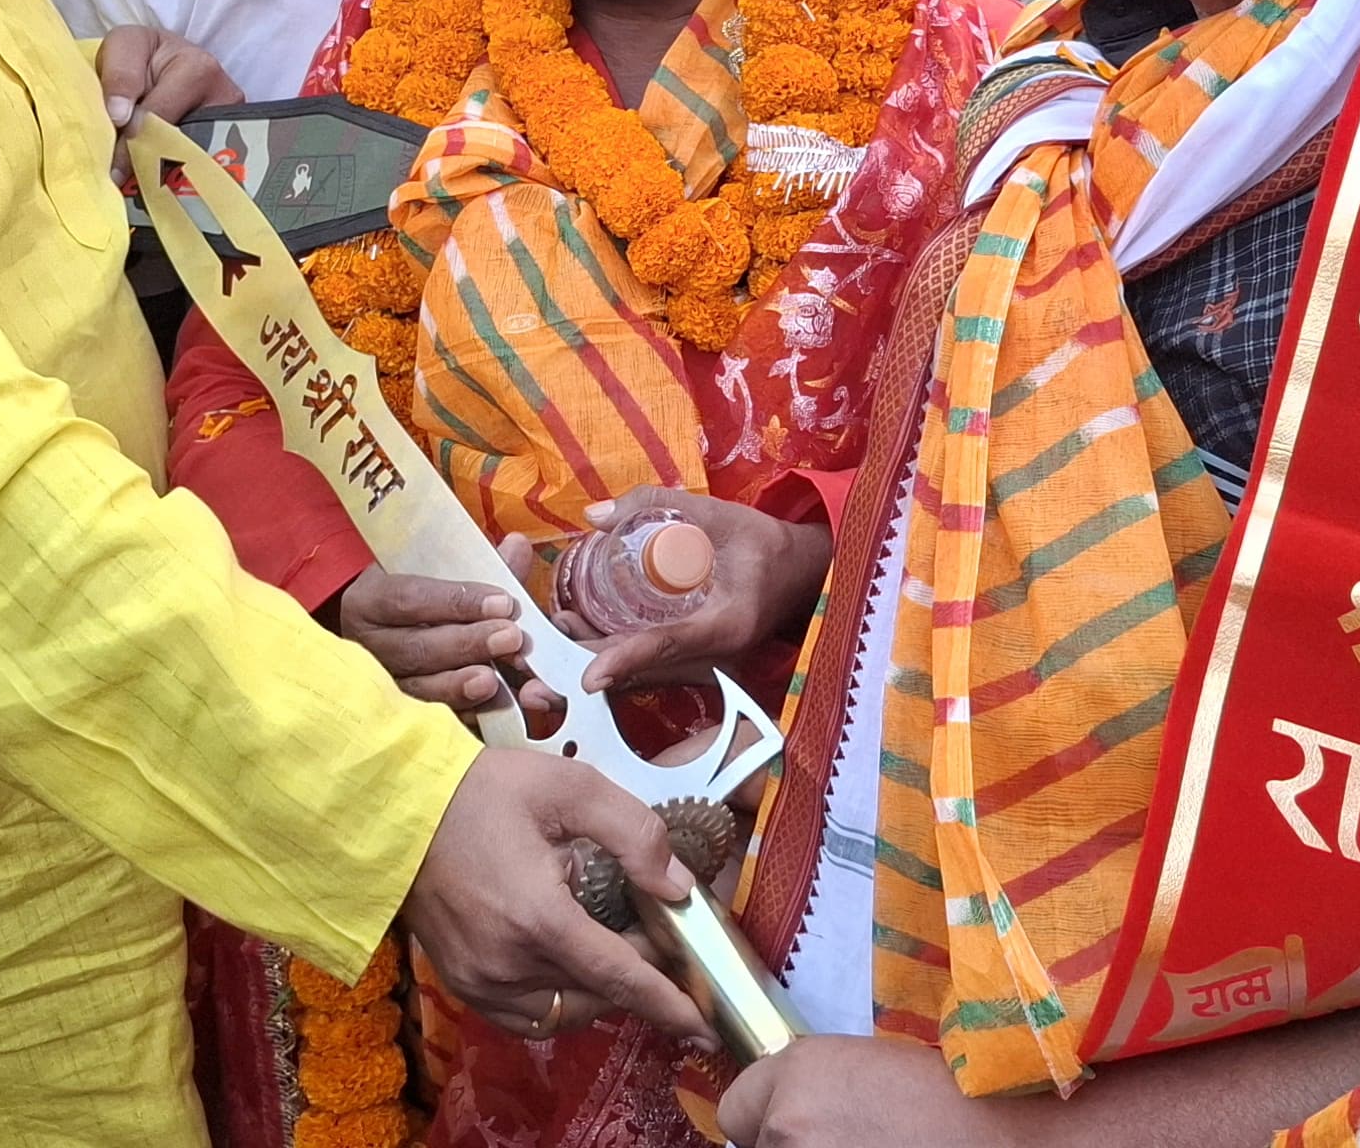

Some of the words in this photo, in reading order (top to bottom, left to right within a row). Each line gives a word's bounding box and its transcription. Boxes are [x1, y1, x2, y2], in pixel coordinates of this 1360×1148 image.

[260, 314, 318, 386] जय
[302, 368, 358, 443] श्री
[341, 419, 406, 514] राम
[1186, 966, 1273, 1018] राम
